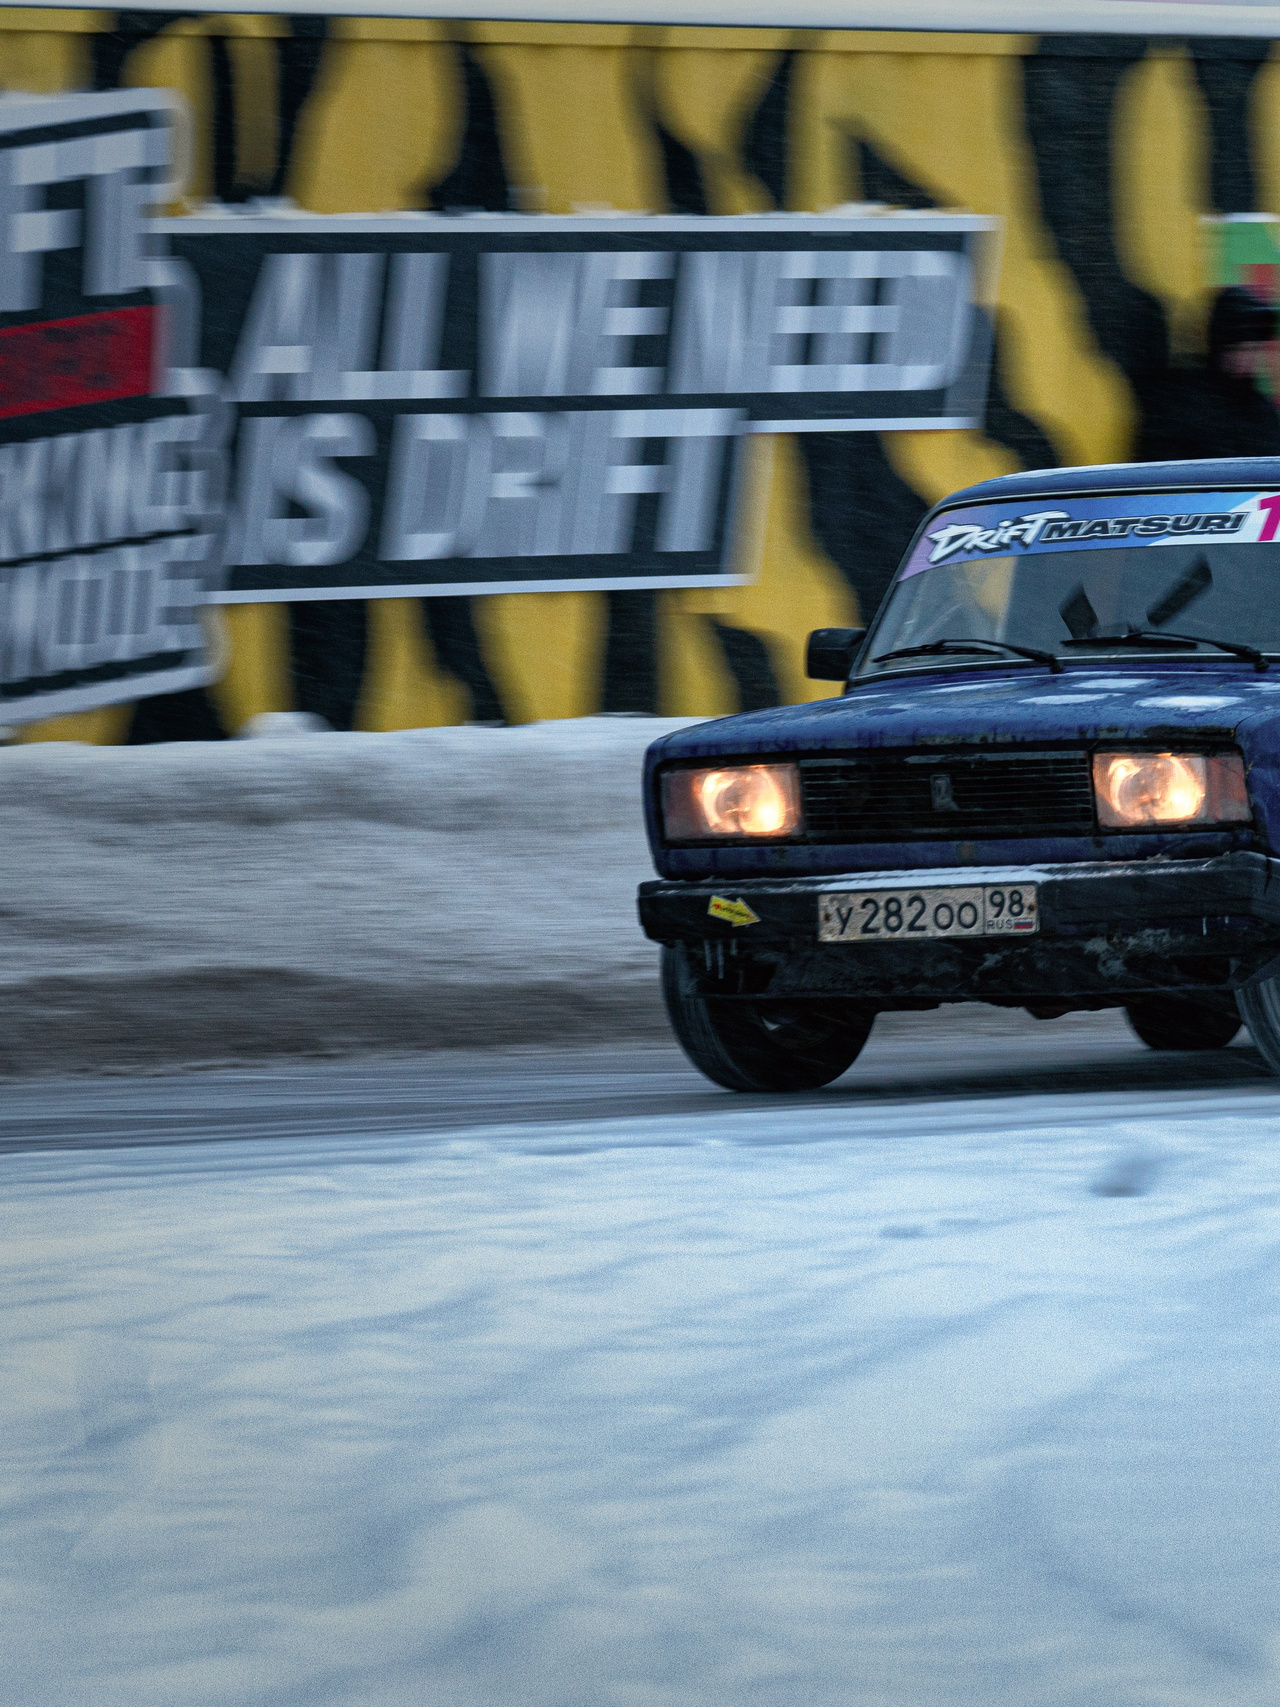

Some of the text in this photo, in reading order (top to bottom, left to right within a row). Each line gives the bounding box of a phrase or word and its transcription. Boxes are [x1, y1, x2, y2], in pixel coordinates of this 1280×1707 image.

[225, 252, 472, 401] ALL
[475, 251, 675, 398] WE
[666, 250, 972, 396] NEED
[224, 408, 750, 566] IS DRIFT
[1038, 511, 1252, 542] MATSURI
[988, 890, 1025, 919] 98
[986, 919, 1014, 930] RUS
